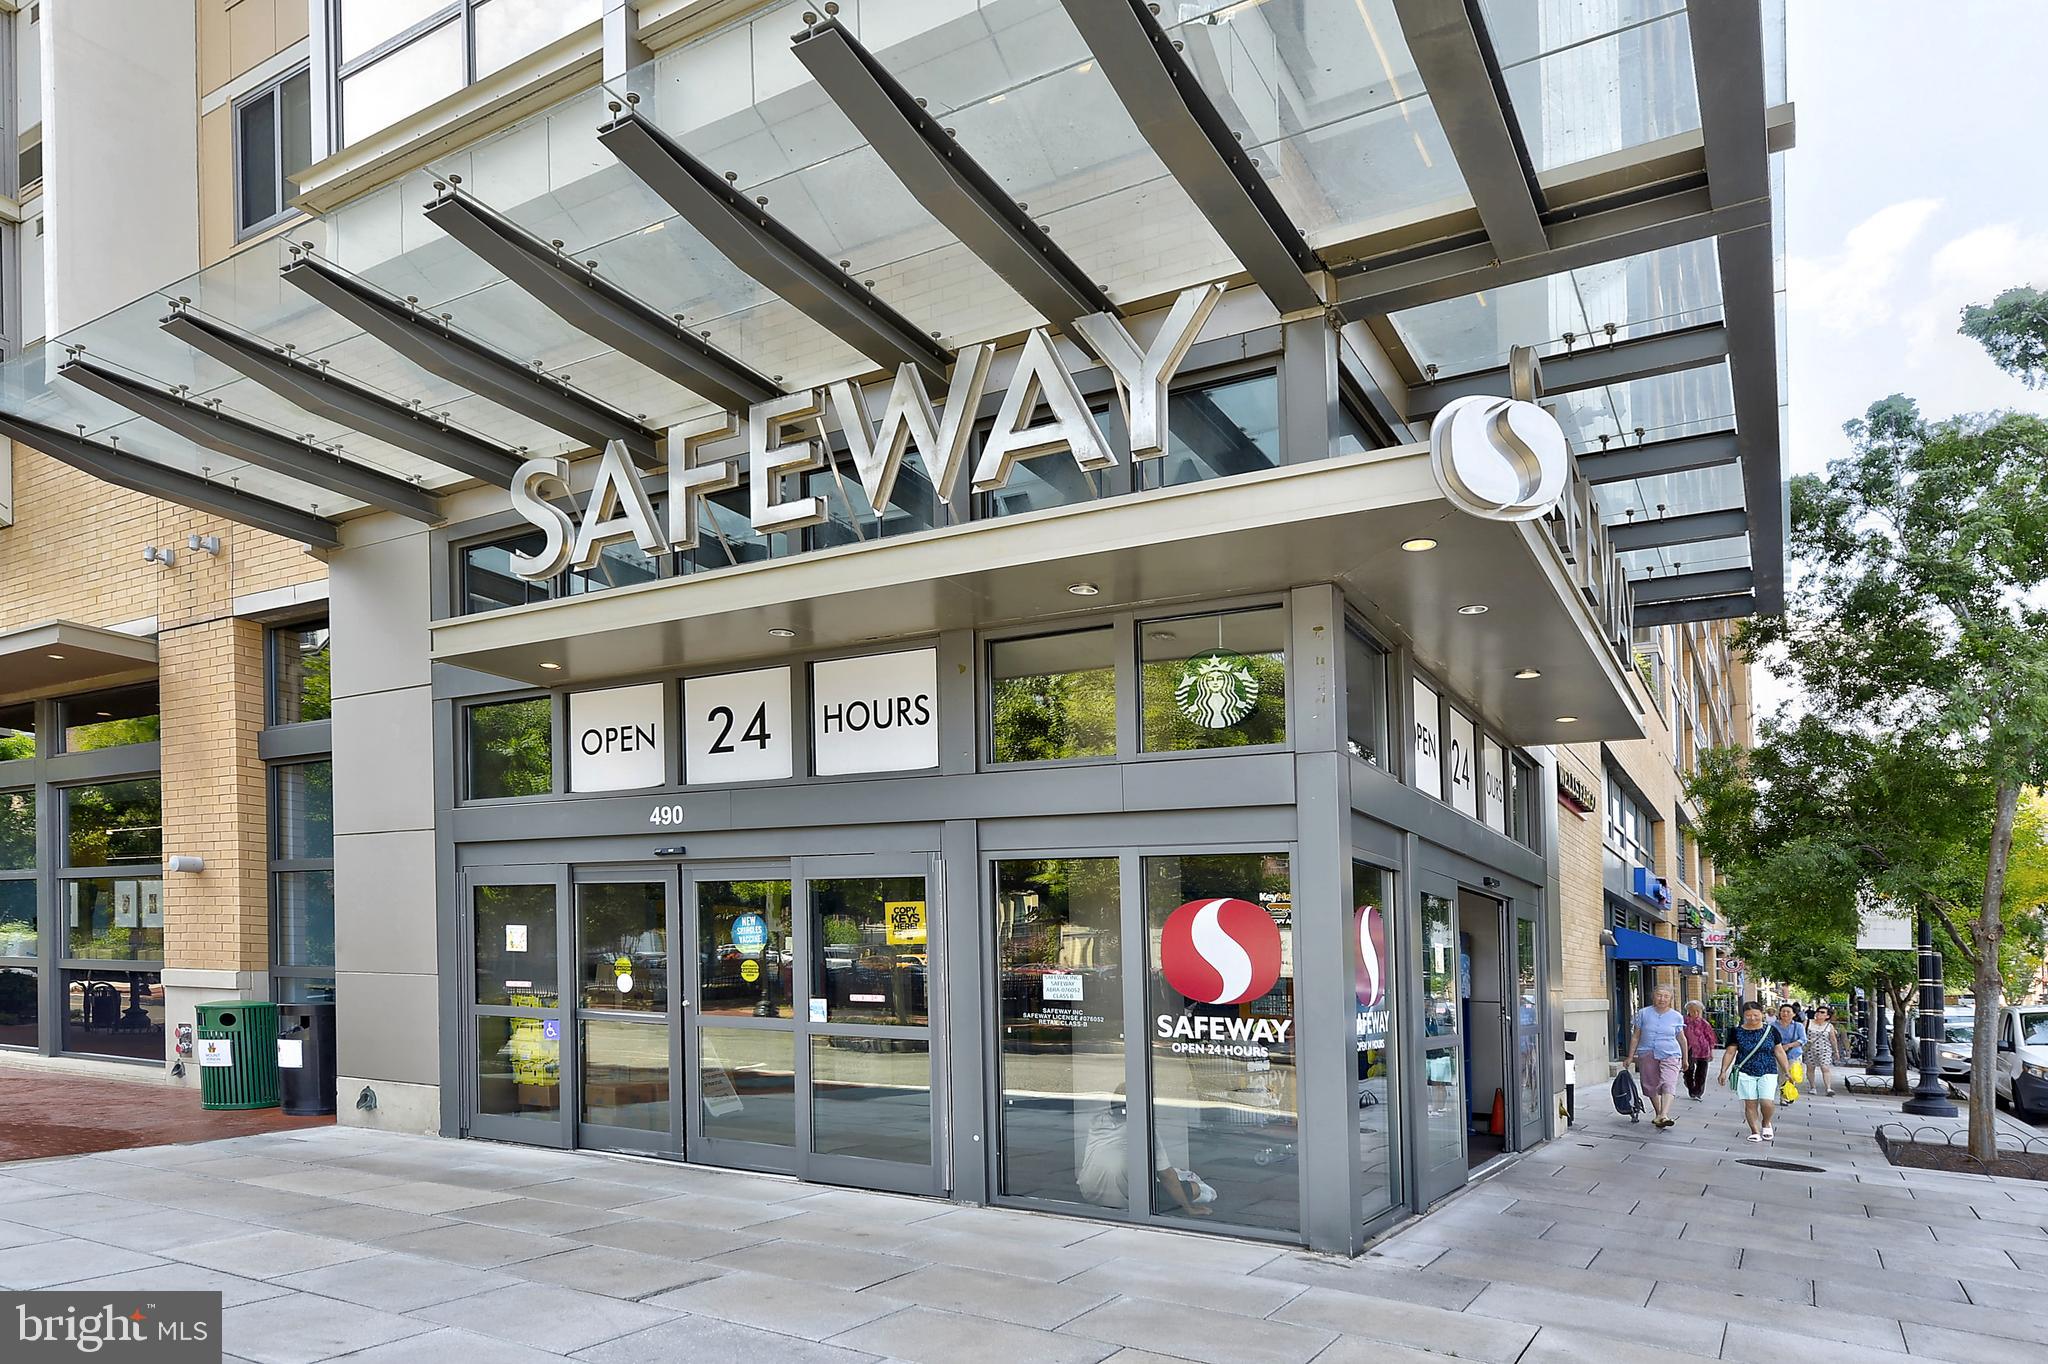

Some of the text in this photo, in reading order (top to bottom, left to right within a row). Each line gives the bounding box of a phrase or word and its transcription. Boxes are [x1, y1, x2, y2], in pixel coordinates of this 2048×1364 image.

[509, 281, 1229, 581] SAFEWAY
[581, 694, 930, 755] OPEN 24 HOURS
[1416, 722, 1502, 803] PEN 24 OURS
[649, 805, 684, 825] 490
[741, 916, 756, 926] NEW
[891, 913, 920, 923] KEYS
[893, 906, 917, 914] COPY
[1157, 1014, 1293, 1043] SAFEWAY
[1356, 1010, 1390, 1035] AFEWAY
[1172, 1042, 1269, 1058] OPEN 24 HOURS
